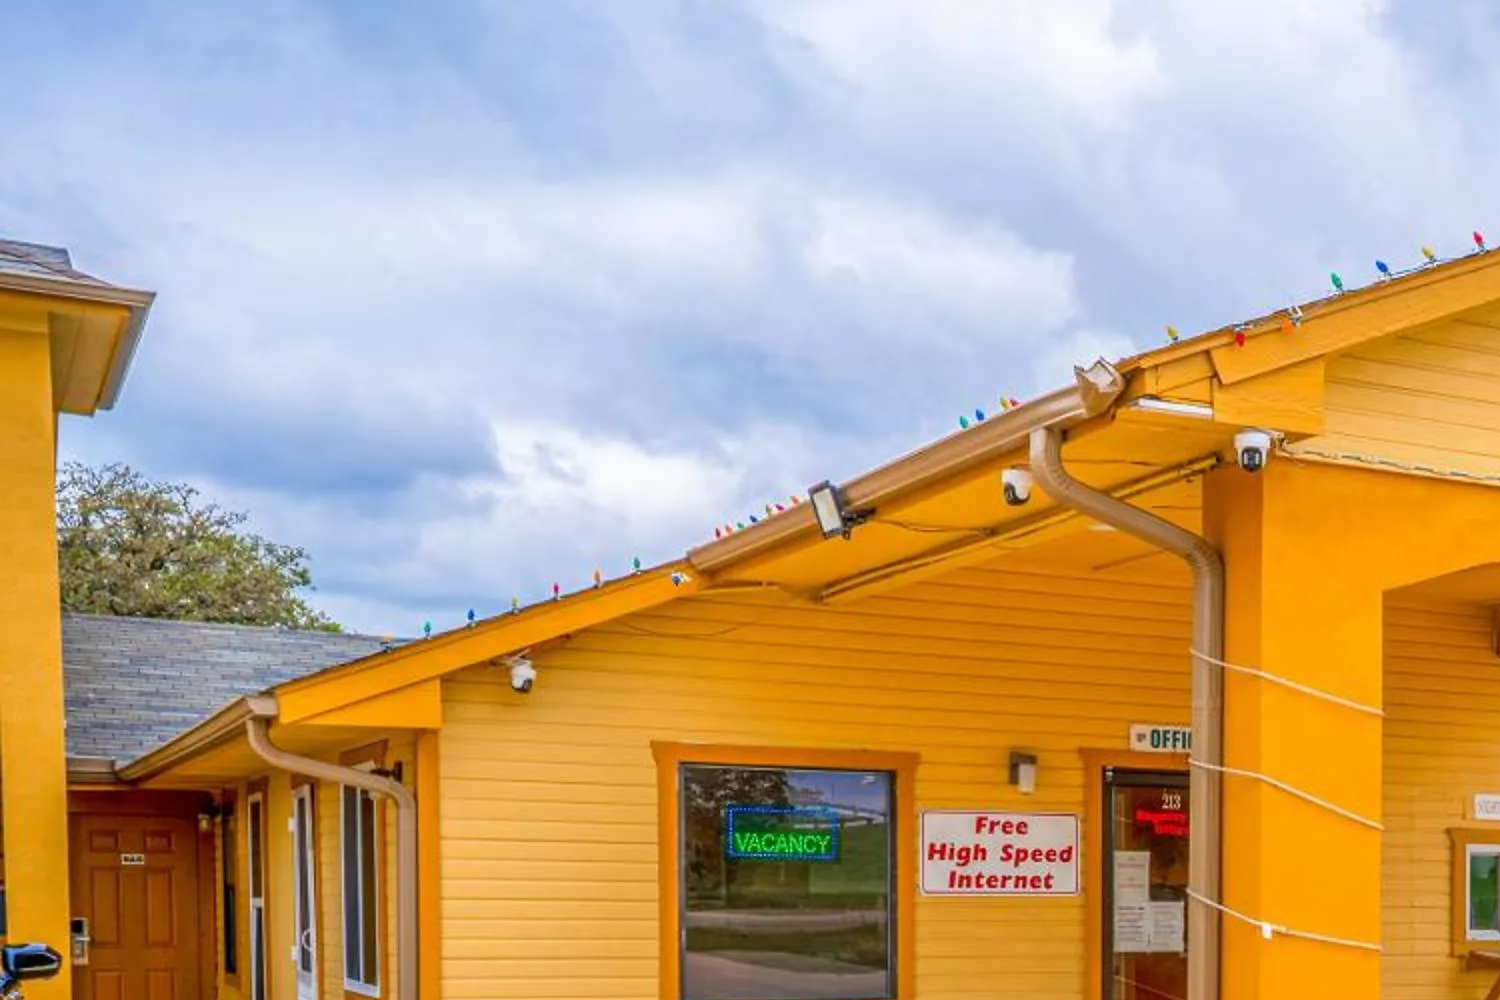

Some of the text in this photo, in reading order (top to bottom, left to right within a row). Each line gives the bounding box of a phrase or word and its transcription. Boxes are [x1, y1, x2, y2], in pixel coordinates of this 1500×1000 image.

[975, 816, 1028, 835] Free
[735, 833, 831, 854] VACANCY
[928, 842, 1073, 867] High Speed
[948, 870, 1054, 889] Internet
